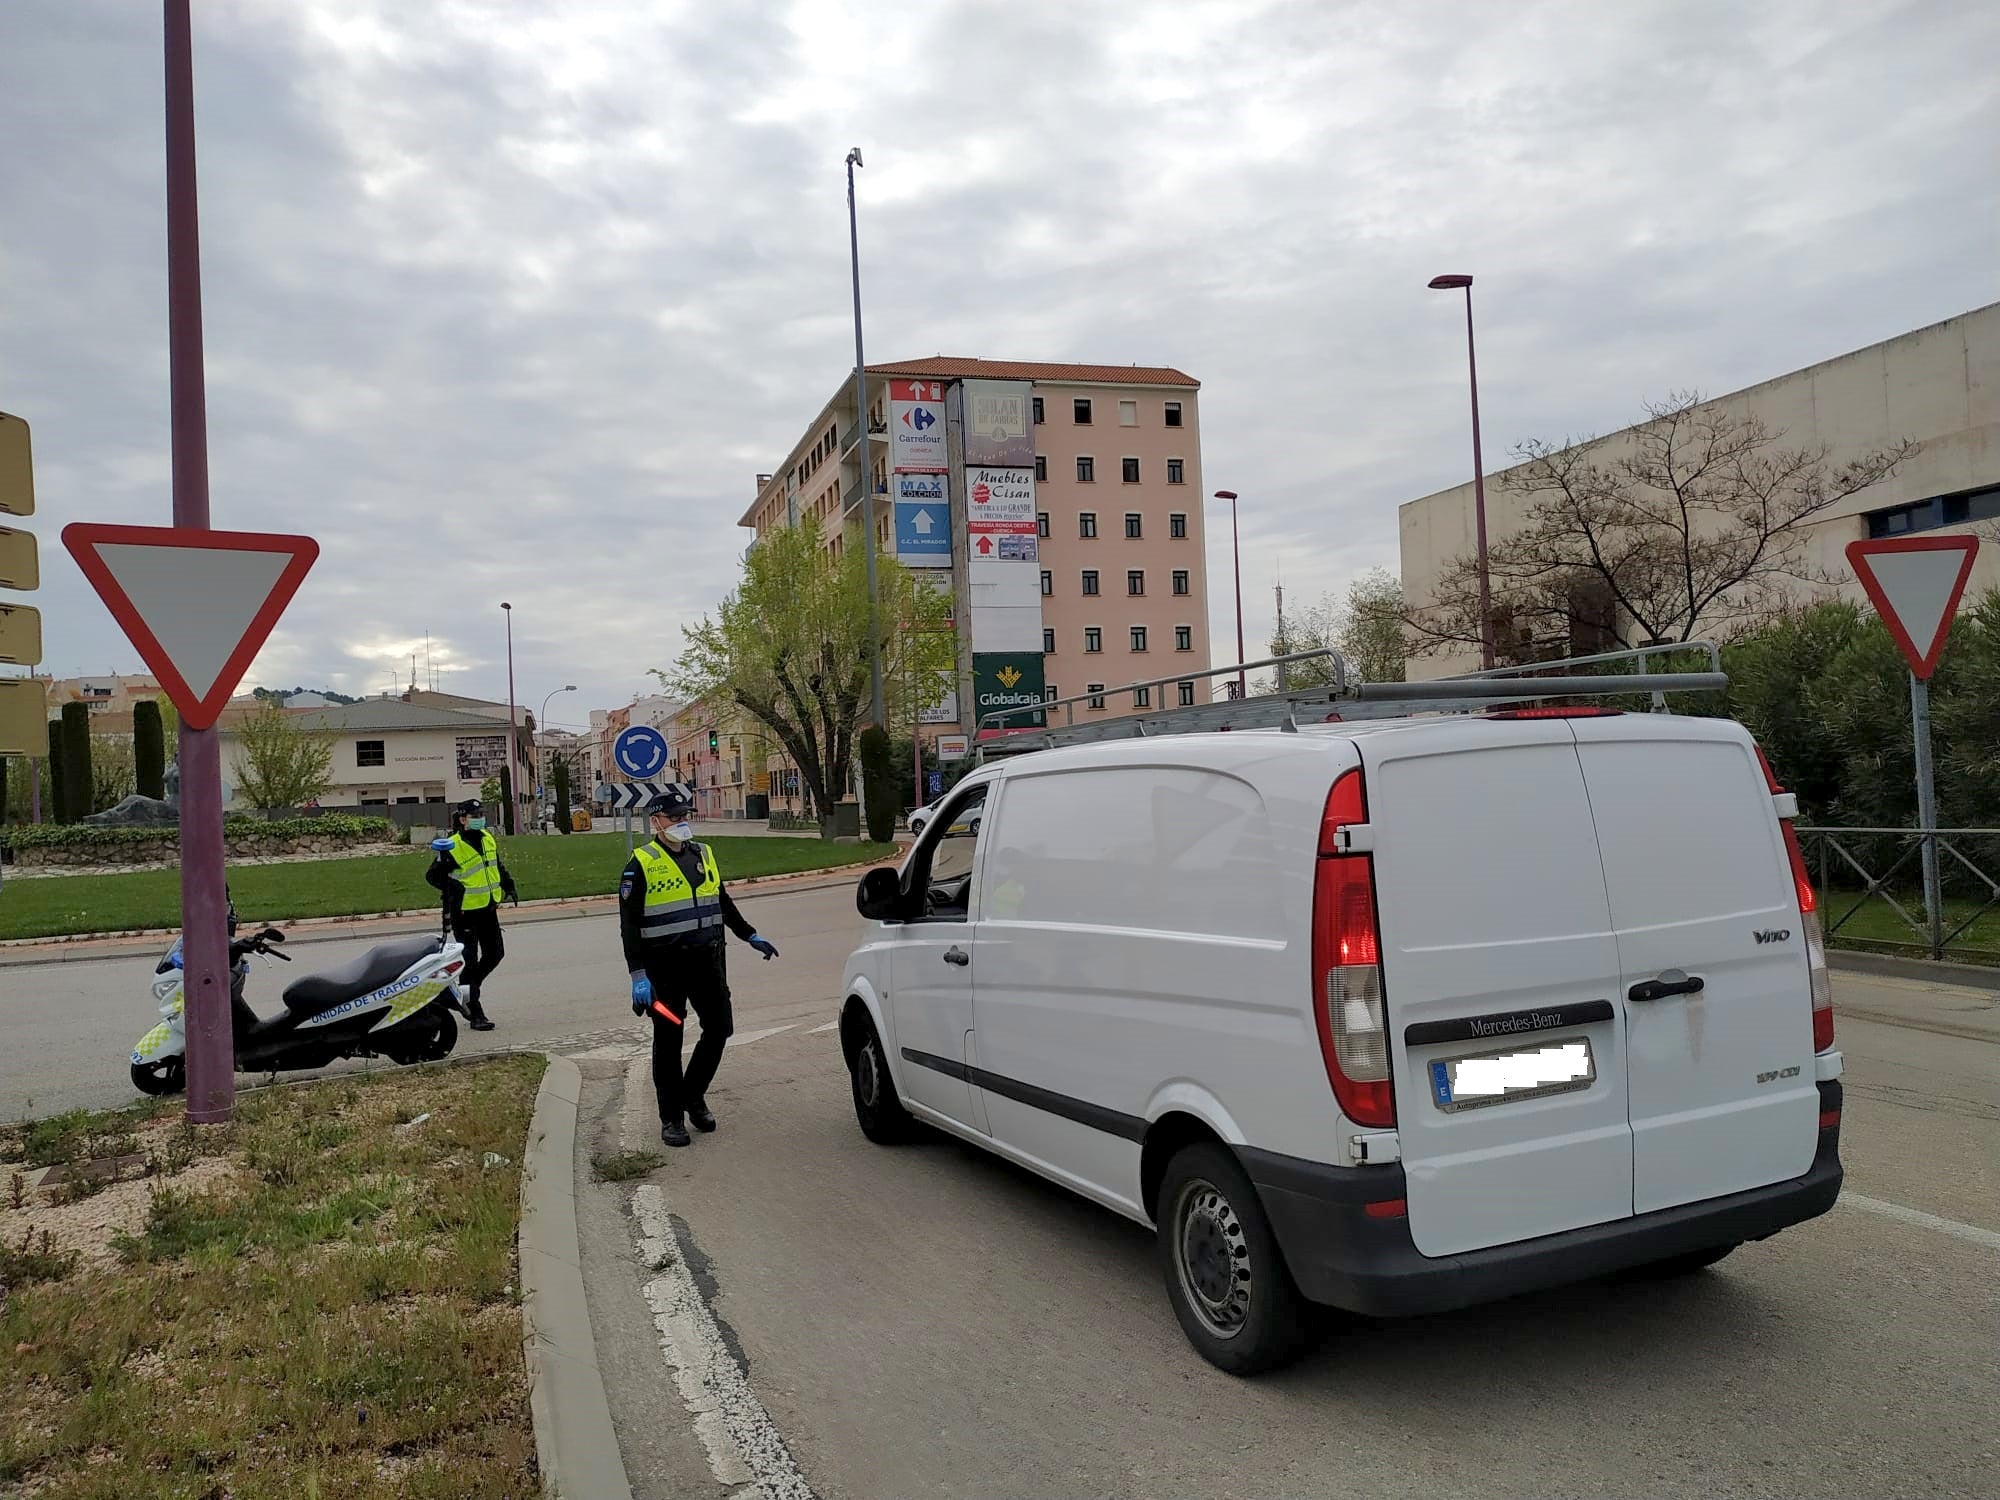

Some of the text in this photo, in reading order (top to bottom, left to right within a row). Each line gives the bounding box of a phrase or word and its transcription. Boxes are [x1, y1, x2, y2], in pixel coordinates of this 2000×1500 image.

[899, 434, 941, 443] Carrefour
[972, 470, 1029, 485] Muebles
[900, 481, 941, 490] MAX
[992, 485, 1030, 498] Cisan
[980, 692, 1041, 706] Globalcaja
[311, 975, 420, 1024] UNIDAD DE TRAFICO
[1470, 1012, 1563, 1037] Mercedes-Benz
[1440, 1087, 1448, 1097] E
